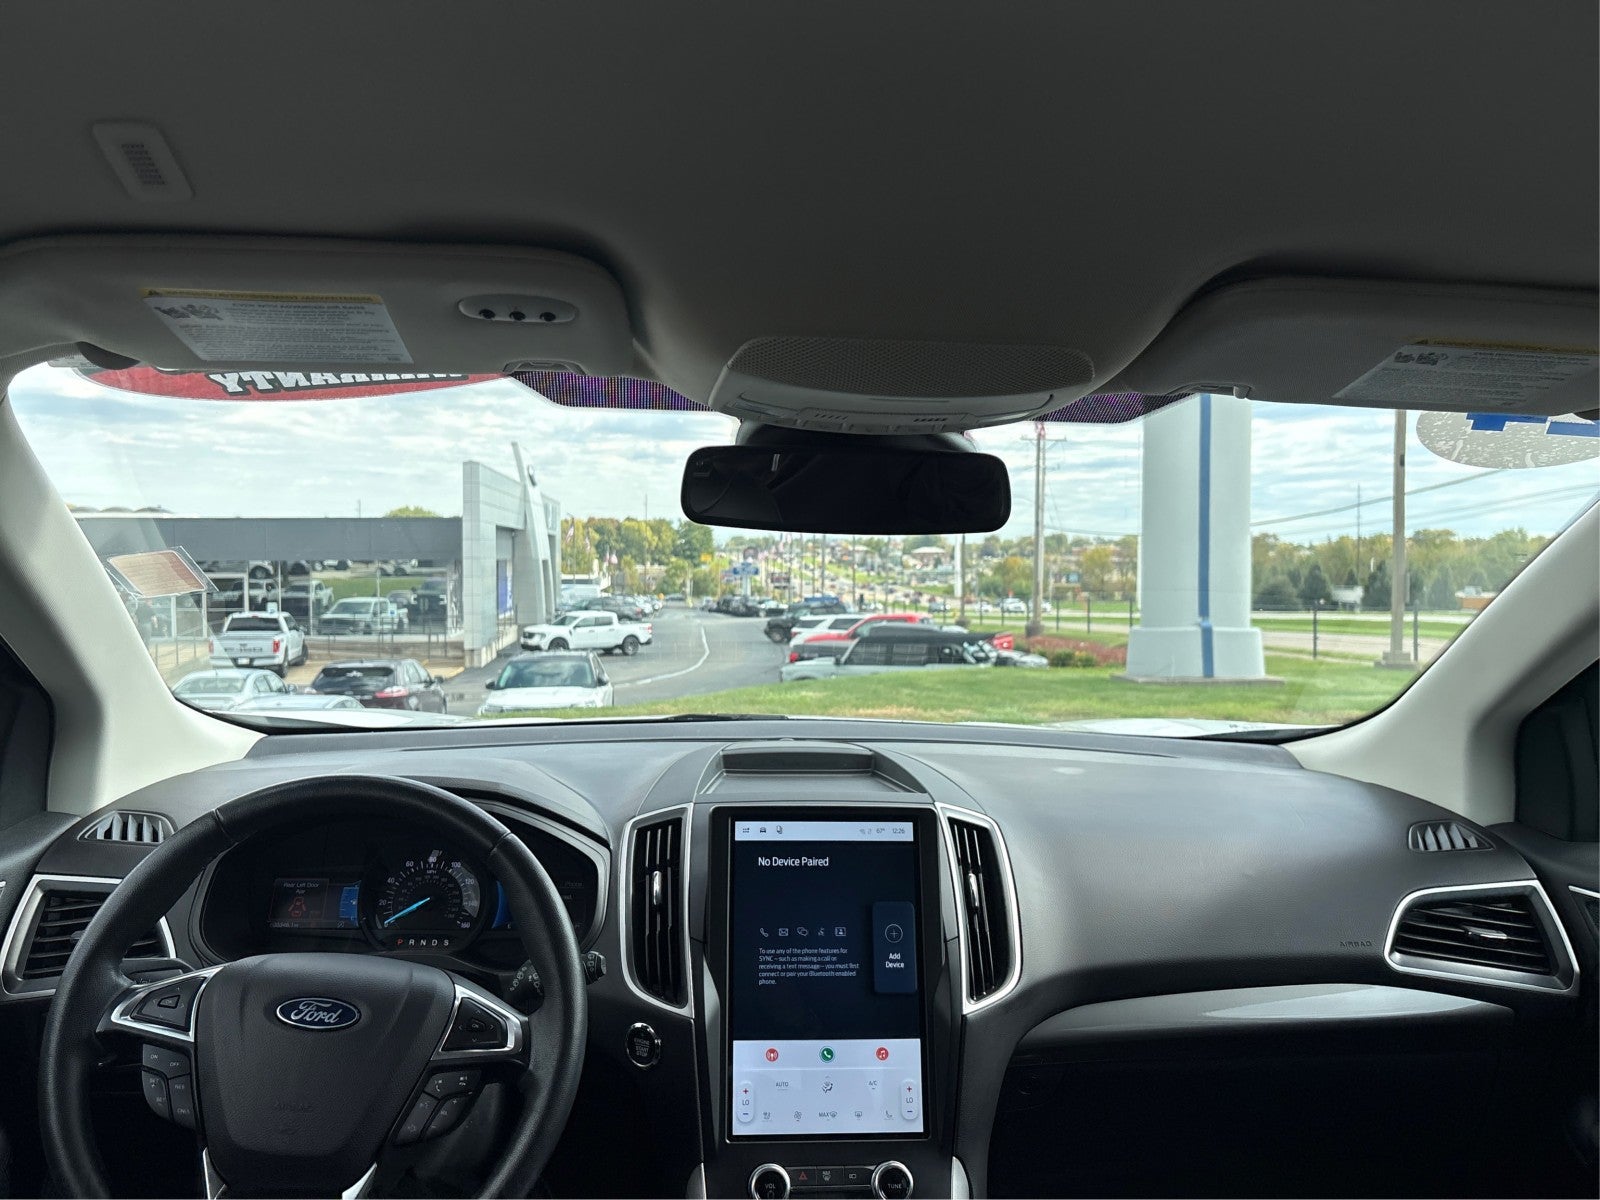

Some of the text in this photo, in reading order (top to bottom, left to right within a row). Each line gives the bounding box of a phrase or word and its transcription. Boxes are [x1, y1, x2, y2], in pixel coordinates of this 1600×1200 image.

[758, 857, 829, 866] No Device Paired
[291, 1000, 340, 1024] Ford
